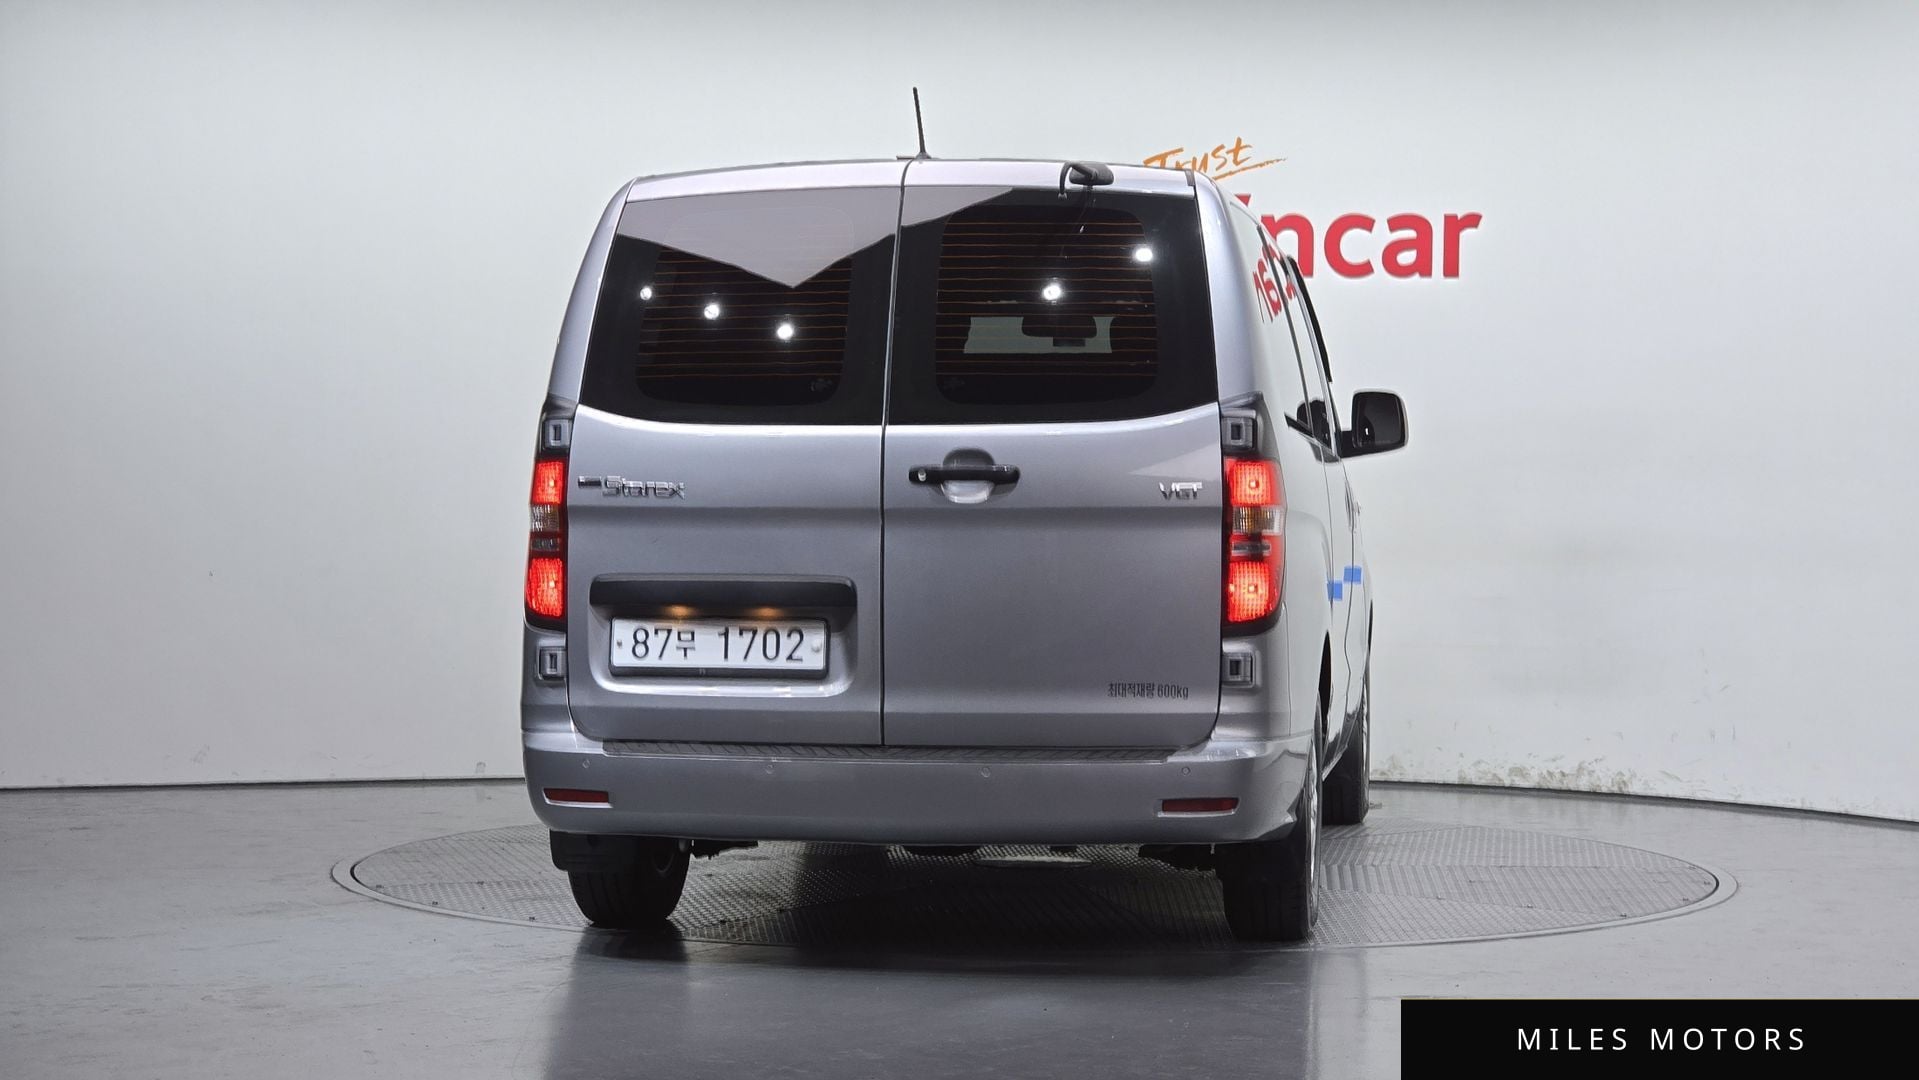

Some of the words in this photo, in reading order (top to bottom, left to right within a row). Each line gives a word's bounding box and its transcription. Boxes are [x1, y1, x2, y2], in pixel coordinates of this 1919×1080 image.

[1235, 193, 1483, 279] ncar
[602, 475, 685, 500] Starex
[631, 626, 696, 660] 87무
[717, 626, 805, 662] 1702
[1108, 682, 1155, 699] 최대적재량
[1157, 684, 1189, 700] 600kg
